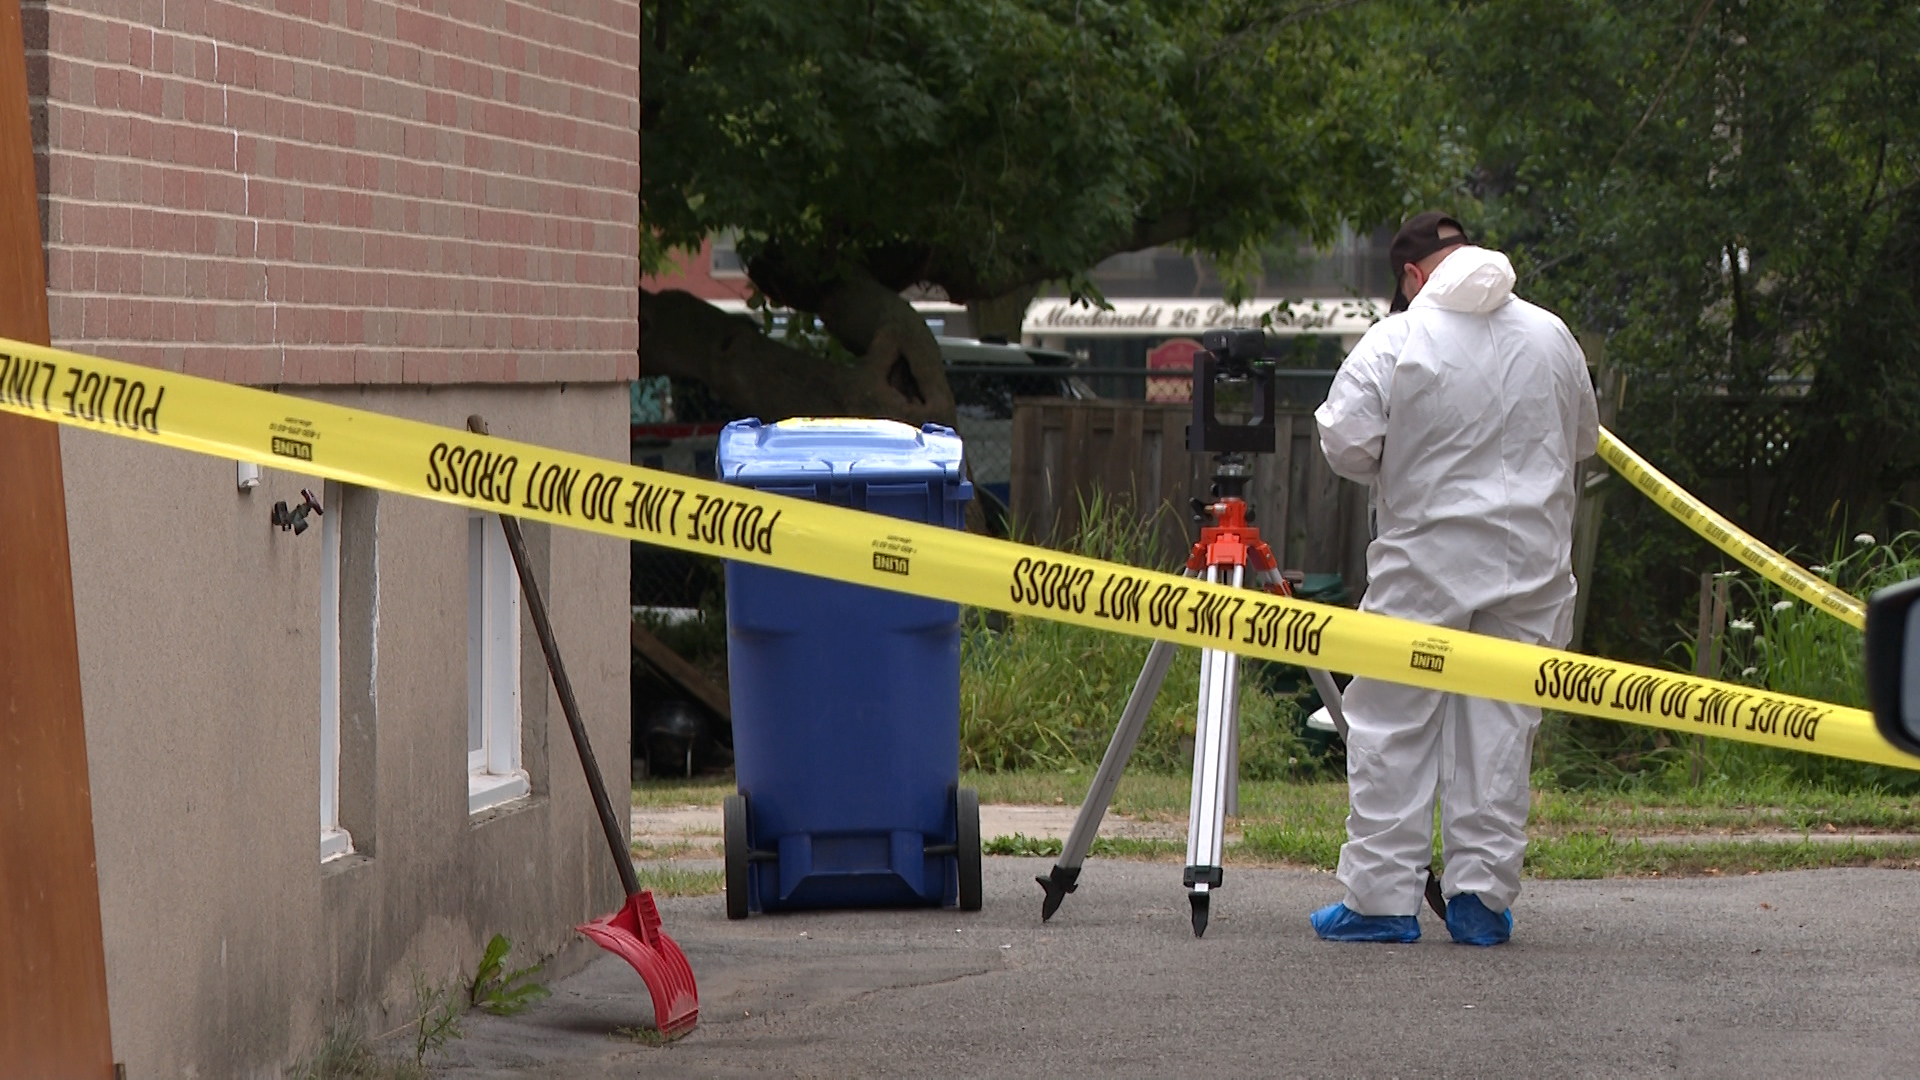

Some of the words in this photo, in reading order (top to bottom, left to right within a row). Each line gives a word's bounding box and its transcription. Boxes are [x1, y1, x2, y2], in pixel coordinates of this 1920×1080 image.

[1034, 304, 1162, 328] Macdonald
[1168, 307, 1199, 328] 26
[63, 367, 165, 435] POLICE
[272, 437, 312, 461] ULINE
[426, 442, 518, 504] CROSS
[522, 461, 580, 516] NOT
[582, 473, 623, 523] DO
[624, 481, 685, 536] LINE
[687, 493, 782, 554] POLICE
[873, 552, 909, 575] ULINE
[1010, 557, 1094, 613] CROSS
[1094, 573, 1150, 623] NOT
[1149, 583, 1188, 629] DO
[1186, 591, 1245, 640] LINE
[1243, 601, 1333, 655] POLICE
[1411, 650, 1445, 673] ULINE
[1535, 658, 1616, 705] CROSS
[1610, 672, 1668, 713] NOT
[1661, 681, 1703, 718] DO
[1693, 687, 1754, 727] LINE
[1745, 697, 1833, 741] POLICE
